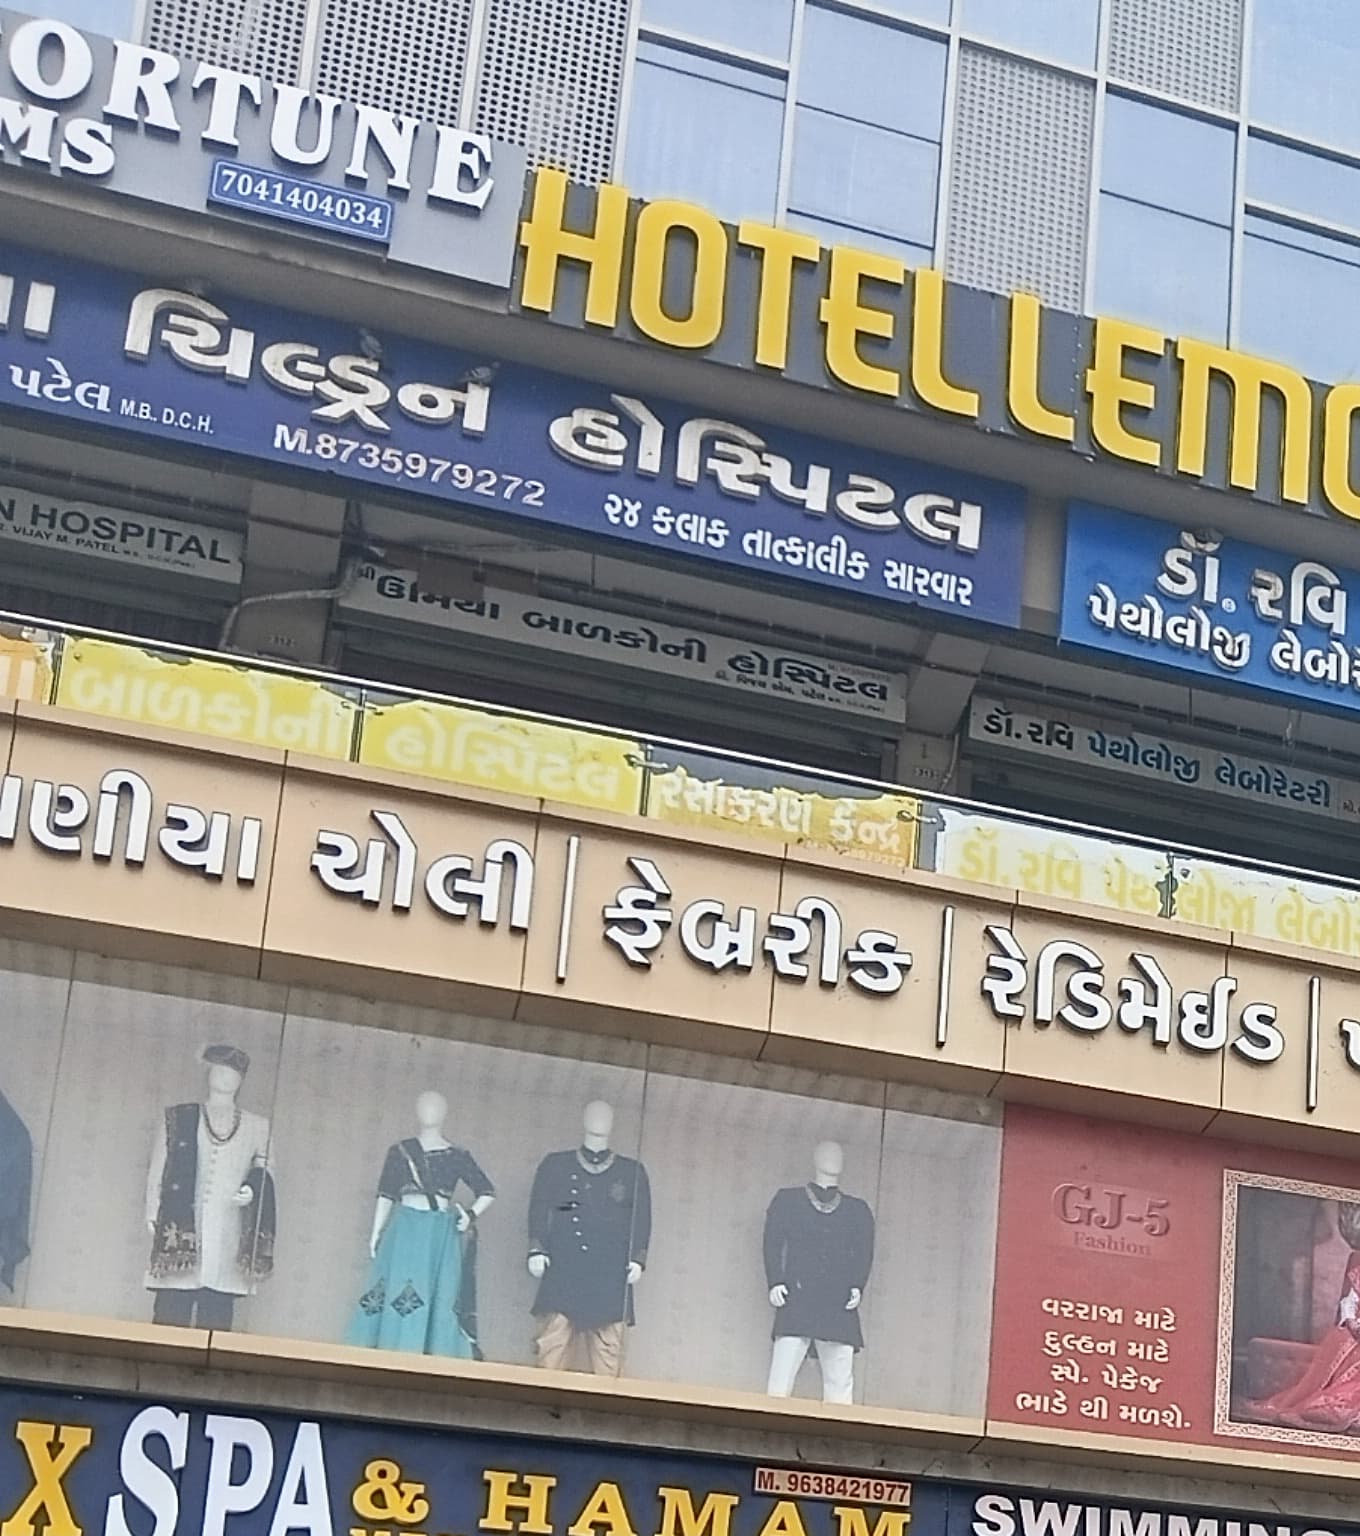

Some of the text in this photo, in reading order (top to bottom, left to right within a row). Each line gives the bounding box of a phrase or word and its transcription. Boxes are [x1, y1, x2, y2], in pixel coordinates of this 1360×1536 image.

[0, 18, 496, 214] ORTUNE
[221, 168, 384, 231] 7041404034
[520, 165, 979, 418] HOTEL
[9, 357, 112, 414] પટેલ
[273, 423, 546, 508] M.8735979272
[548, 394, 983, 552] હોસ્પિટલ
[30, 500, 231, 565] HOSPITAL
[75, 536, 120, 555] PATEL
[603, 493, 974, 607] ૨૪ કલાક તાત્કાલીક સારવાર
[1089, 581, 1251, 672] પેથોલોજી
[1249, 560, 1349, 637] રવિ
[522, 609, 707, 665] બાળકોની
[727, 651, 889, 702] હોસ્પિટલ
[1087, 730, 1331, 810] પેથોલોજી લેબોરેટરી
[311, 809, 535, 931] ચોલી
[602, 856, 913, 996] ફેબ્રીક
[1050, 1180, 1171, 1239] GJ-5
[1073, 1229, 1152, 1258] Fashion
[1041, 1297, 1177, 1333] વરરાજા માટે
[1044, 1329, 1170, 1364] દુલ્હન માટે
[1016, 1389, 1069, 1416] ભાડે
[1079, 1393, 1110, 1421] થી
[1101, 1366, 1163, 1394] પેકેજ
[352, 1459, 429, 1526] &
[758, 1469, 910, 1505] M. 9638421977
